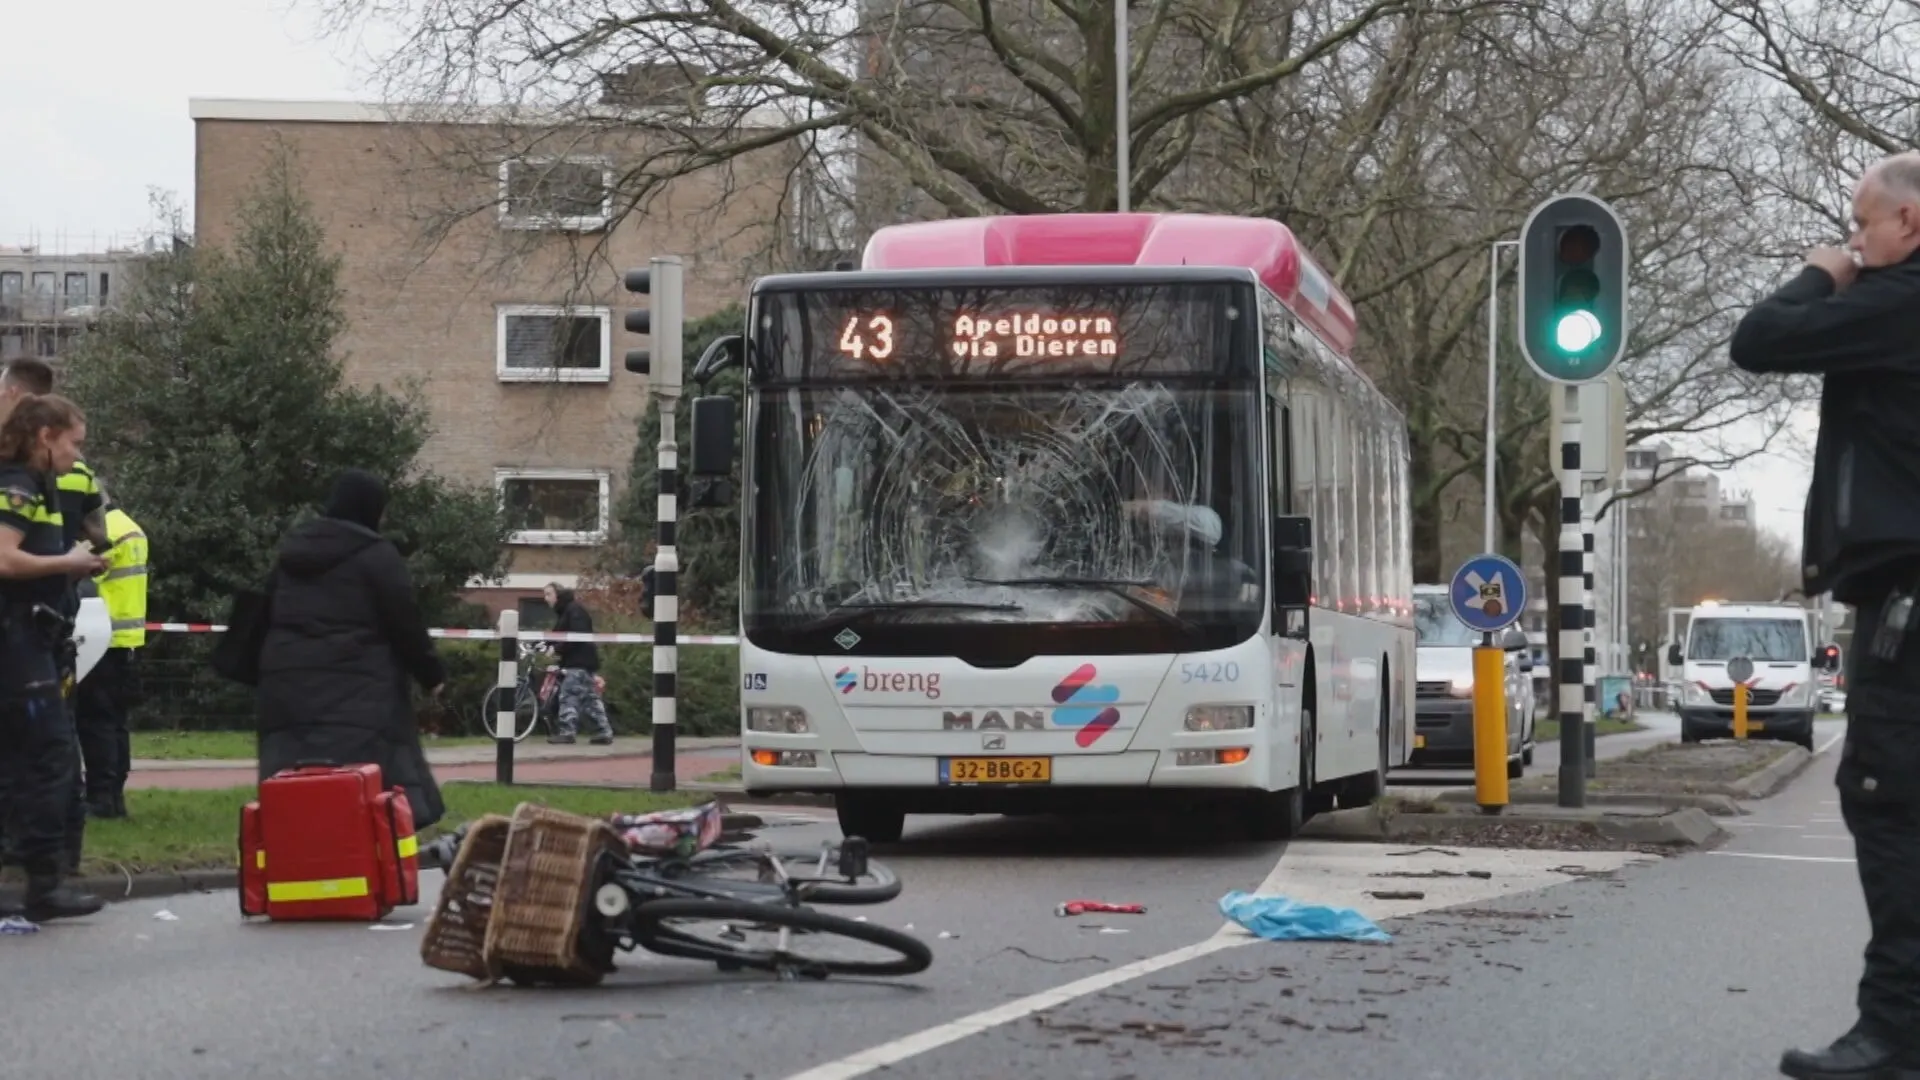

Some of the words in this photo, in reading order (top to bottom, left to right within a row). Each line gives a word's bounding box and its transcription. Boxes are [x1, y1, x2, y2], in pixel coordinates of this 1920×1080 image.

[839, 315, 893, 358] 43
[955, 314, 1112, 338] Apeldoorn
[953, 336, 998, 357] via
[1015, 334, 1117, 357] Dieren
[863, 665, 941, 700] breng
[1181, 661, 1240, 684] 5420
[943, 710, 1045, 730] MAN
[955, 761, 1043, 779] 32-BBG-2
